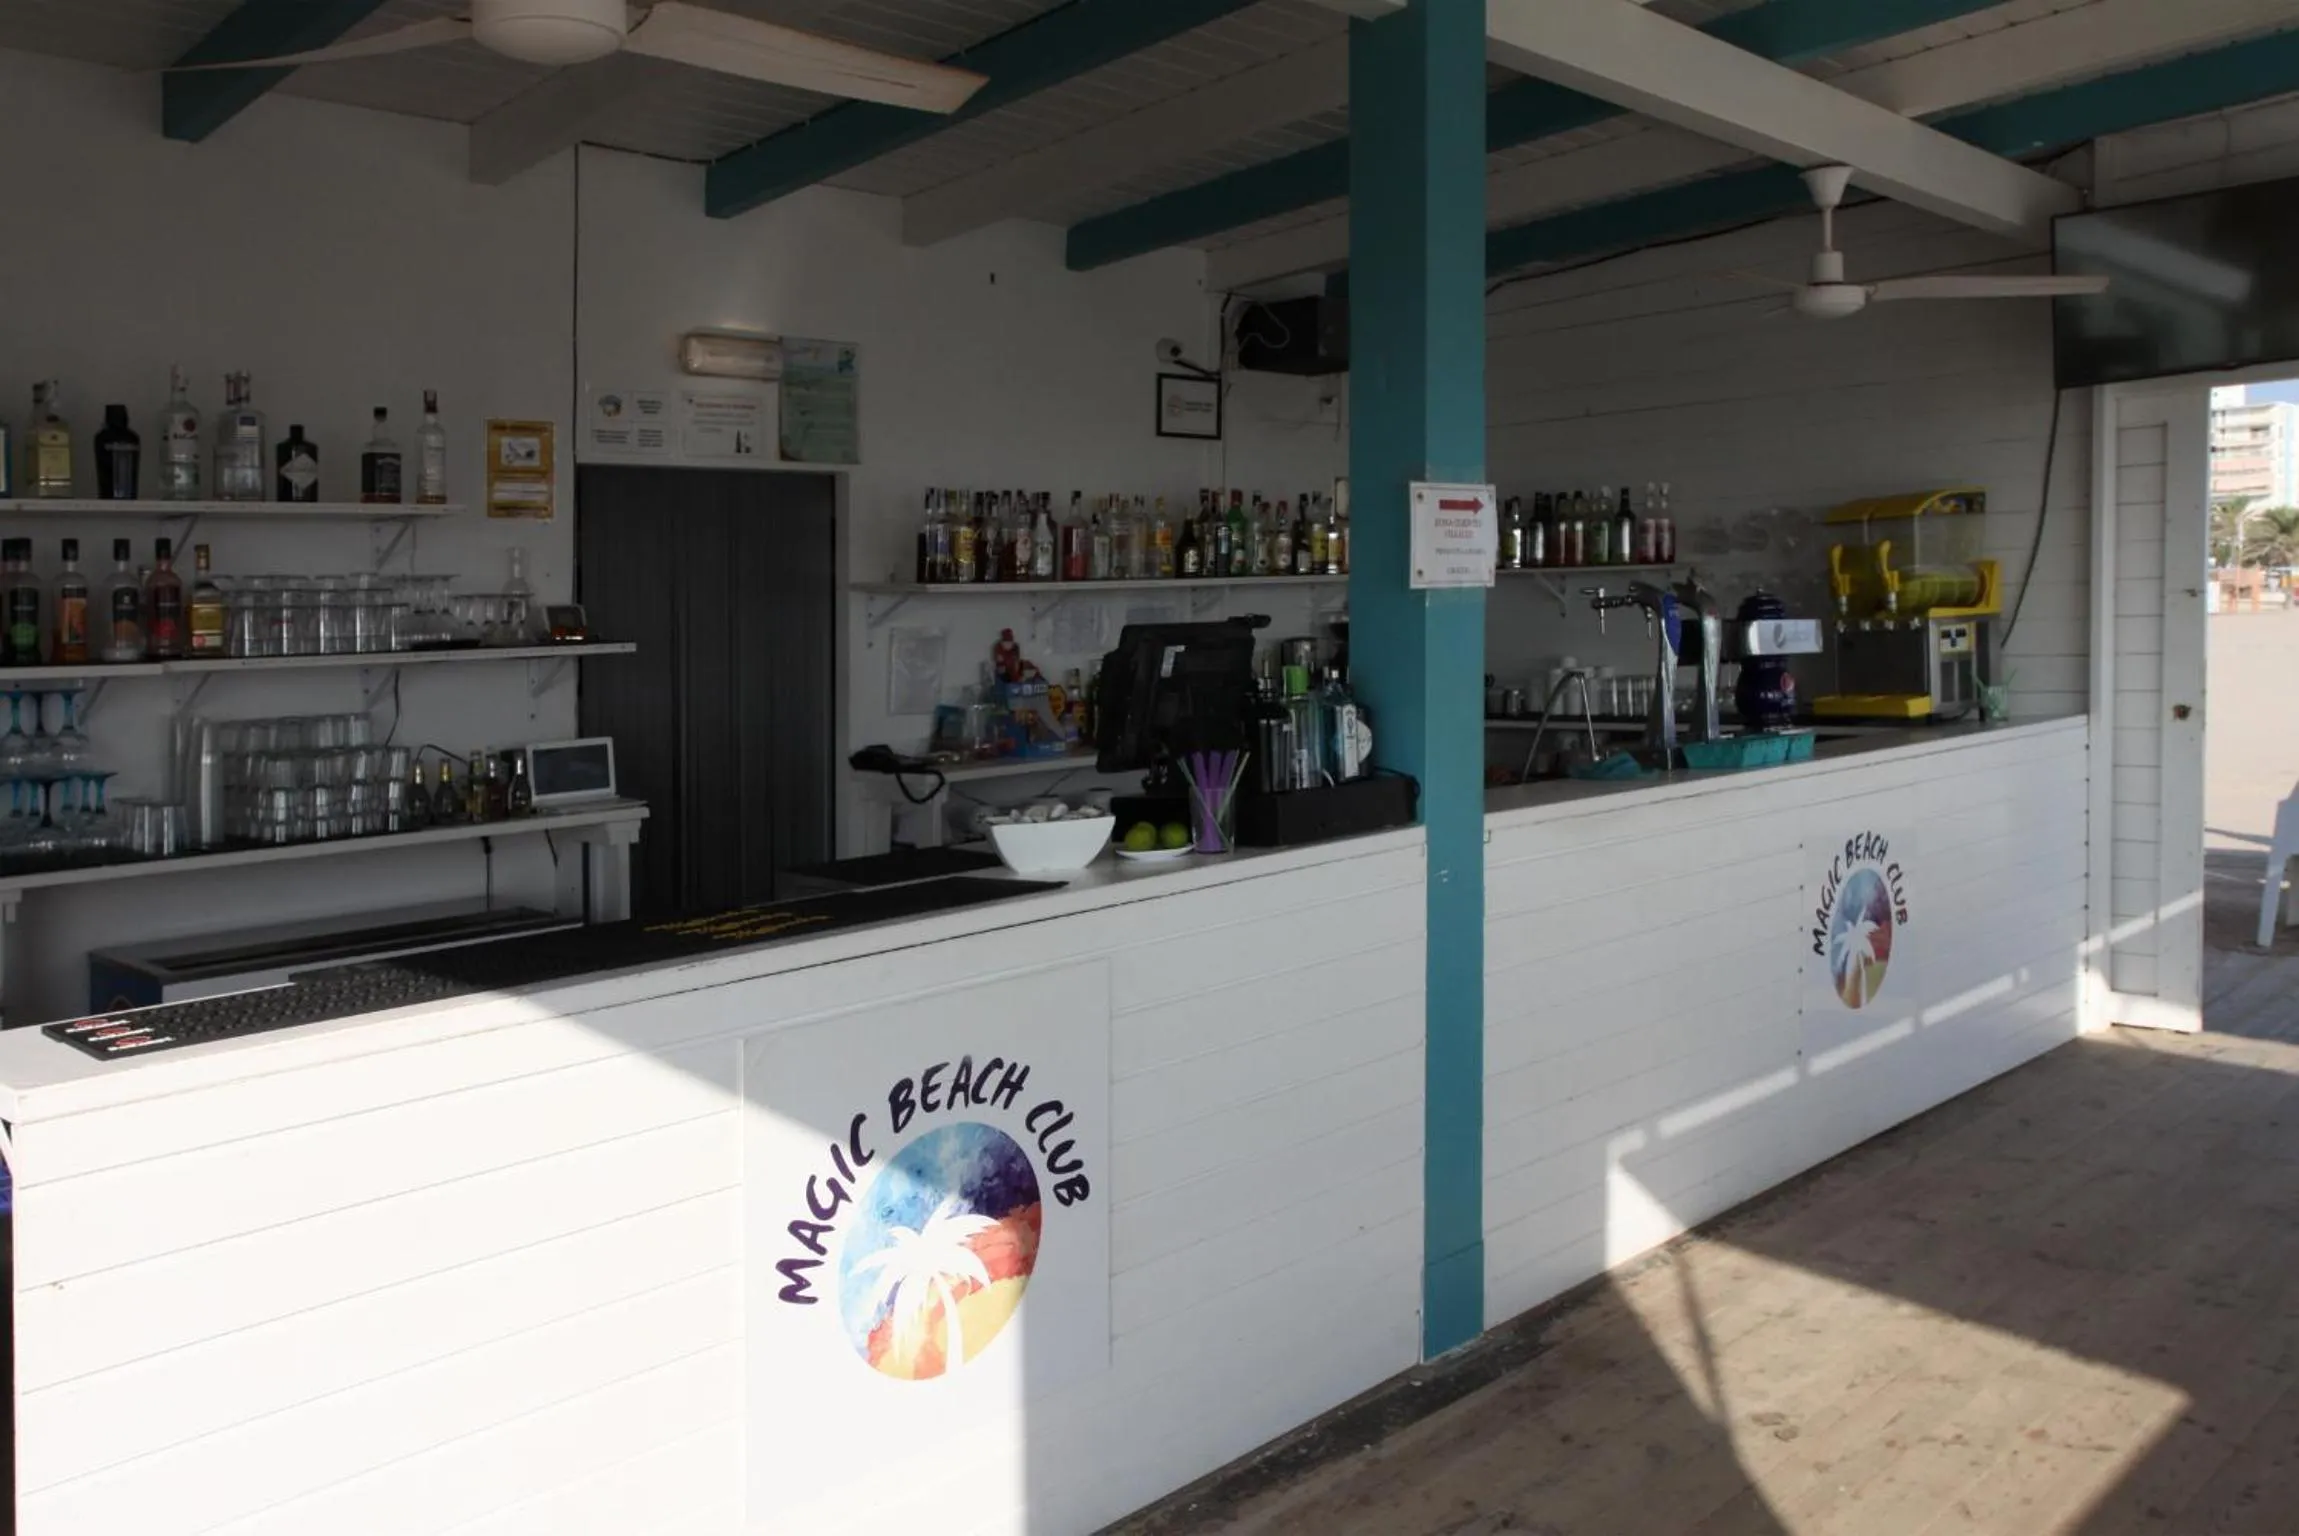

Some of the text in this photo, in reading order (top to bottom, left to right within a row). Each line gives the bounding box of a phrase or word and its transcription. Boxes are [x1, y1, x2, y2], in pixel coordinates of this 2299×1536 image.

[1813, 831, 1908, 956] MAGIC BEACH CLUB
[776, 1055, 1090, 1304] MAGIC BEACH CLUB
